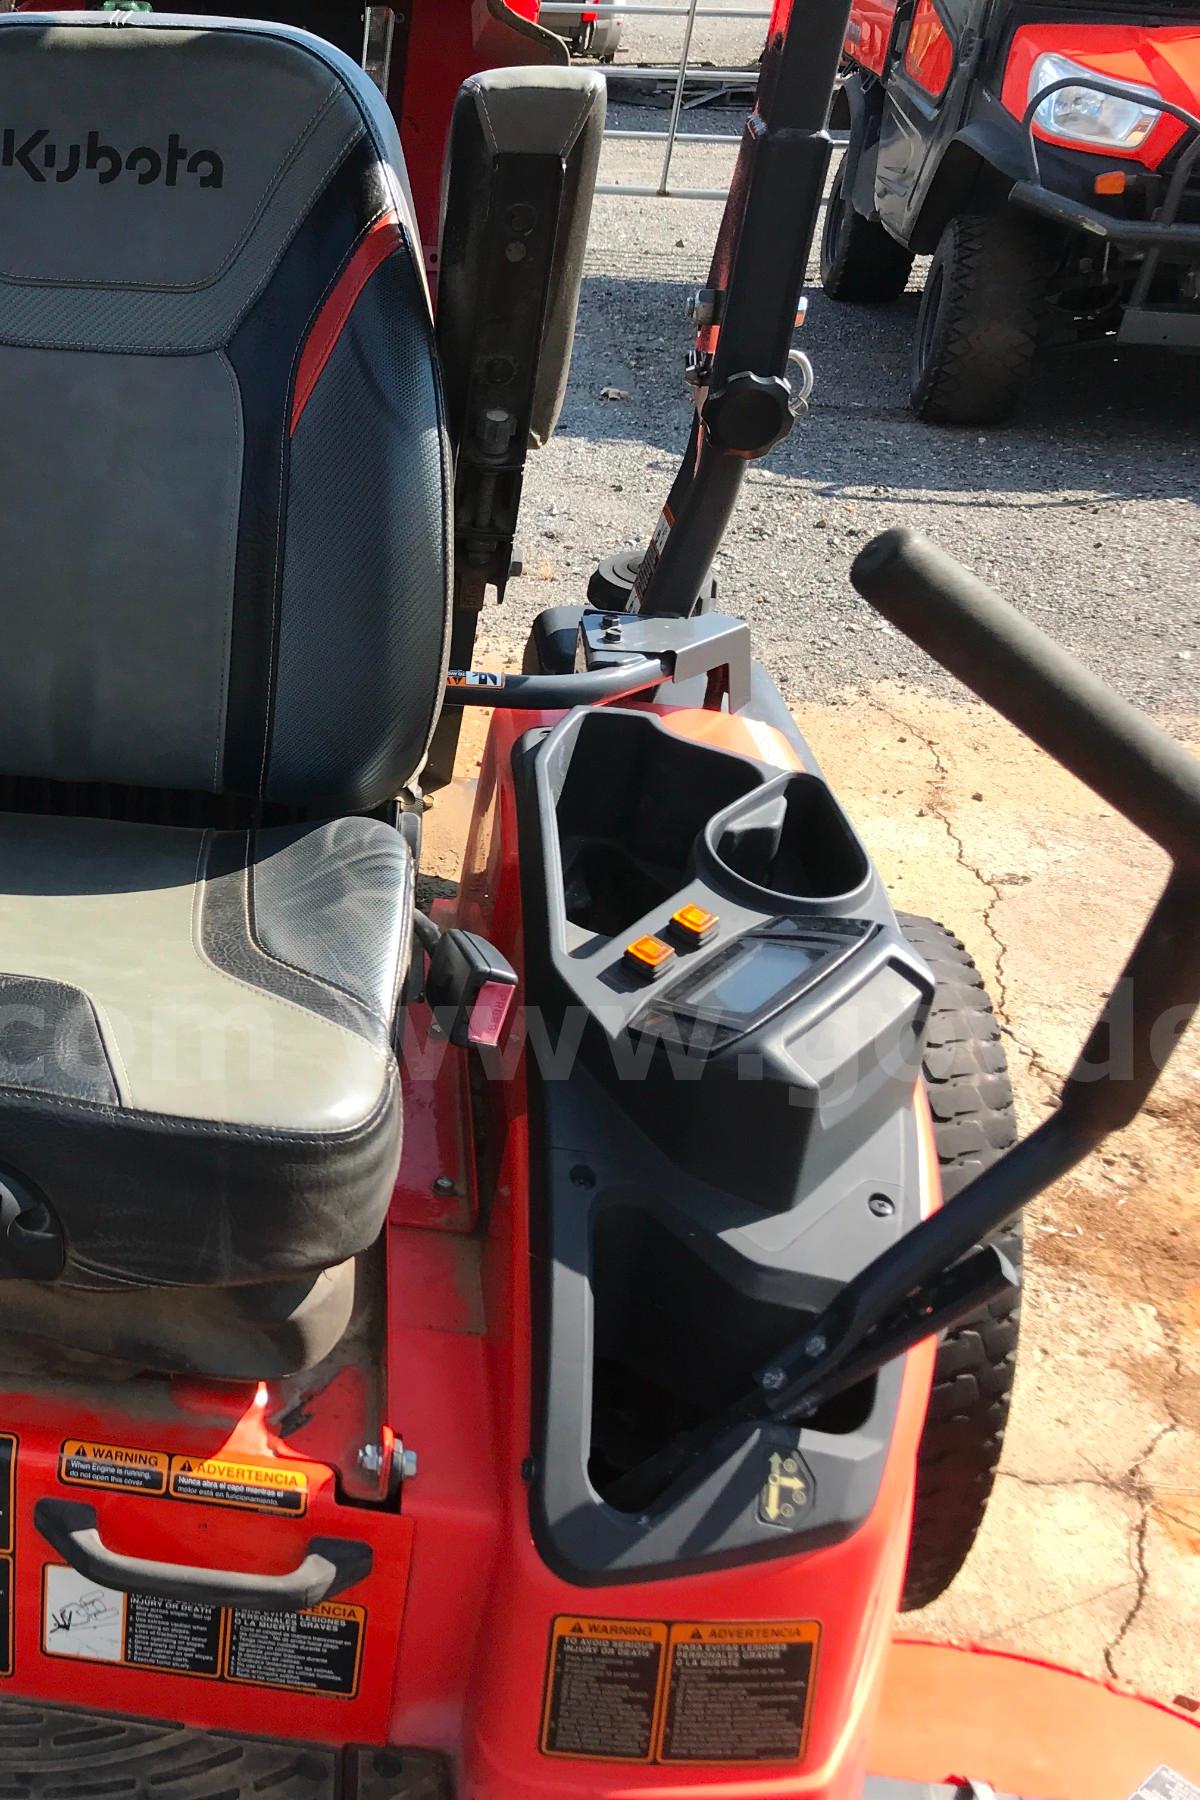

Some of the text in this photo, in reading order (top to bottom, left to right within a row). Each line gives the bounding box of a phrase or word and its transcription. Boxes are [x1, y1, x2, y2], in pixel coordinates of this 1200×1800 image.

[2, 128, 224, 189] Kubota
[92, 1447, 158, 1466] WARNING
[70, 1460, 151, 1479] When Engine is running,
[196, 1462, 297, 1486] ADVERTENCIA
[79, 1471, 90, 1479] not
[91, 1474, 108, 1482] open
[110, 1475, 122, 1483] this
[178, 1476, 200, 1486] Nunca
[201, 1479, 218, 1488] abra
[219, 1481, 225, 1489] el
[245, 1484, 275, 1495] mientras
[276, 1488, 283, 1496] el
[130, 1598, 162, 1608] INJURY
[164, 1602, 178, 1610] OR
[180, 1603, 211, 1613] DEATH
[234, 1612, 338, 1632] PERSONALES GRAVES
[234, 1618, 296, 1632] O LA MUERTE
[299, 1614, 346, 1626] LESIONES
[588, 1623, 652, 1636] WARNING
[708, 1627, 801, 1639] ADVERTENCIA
[564, 1637, 654, 1649] TO AVOID SERIOUS
[563, 1645, 650, 1656] INJURY OR DEATH
